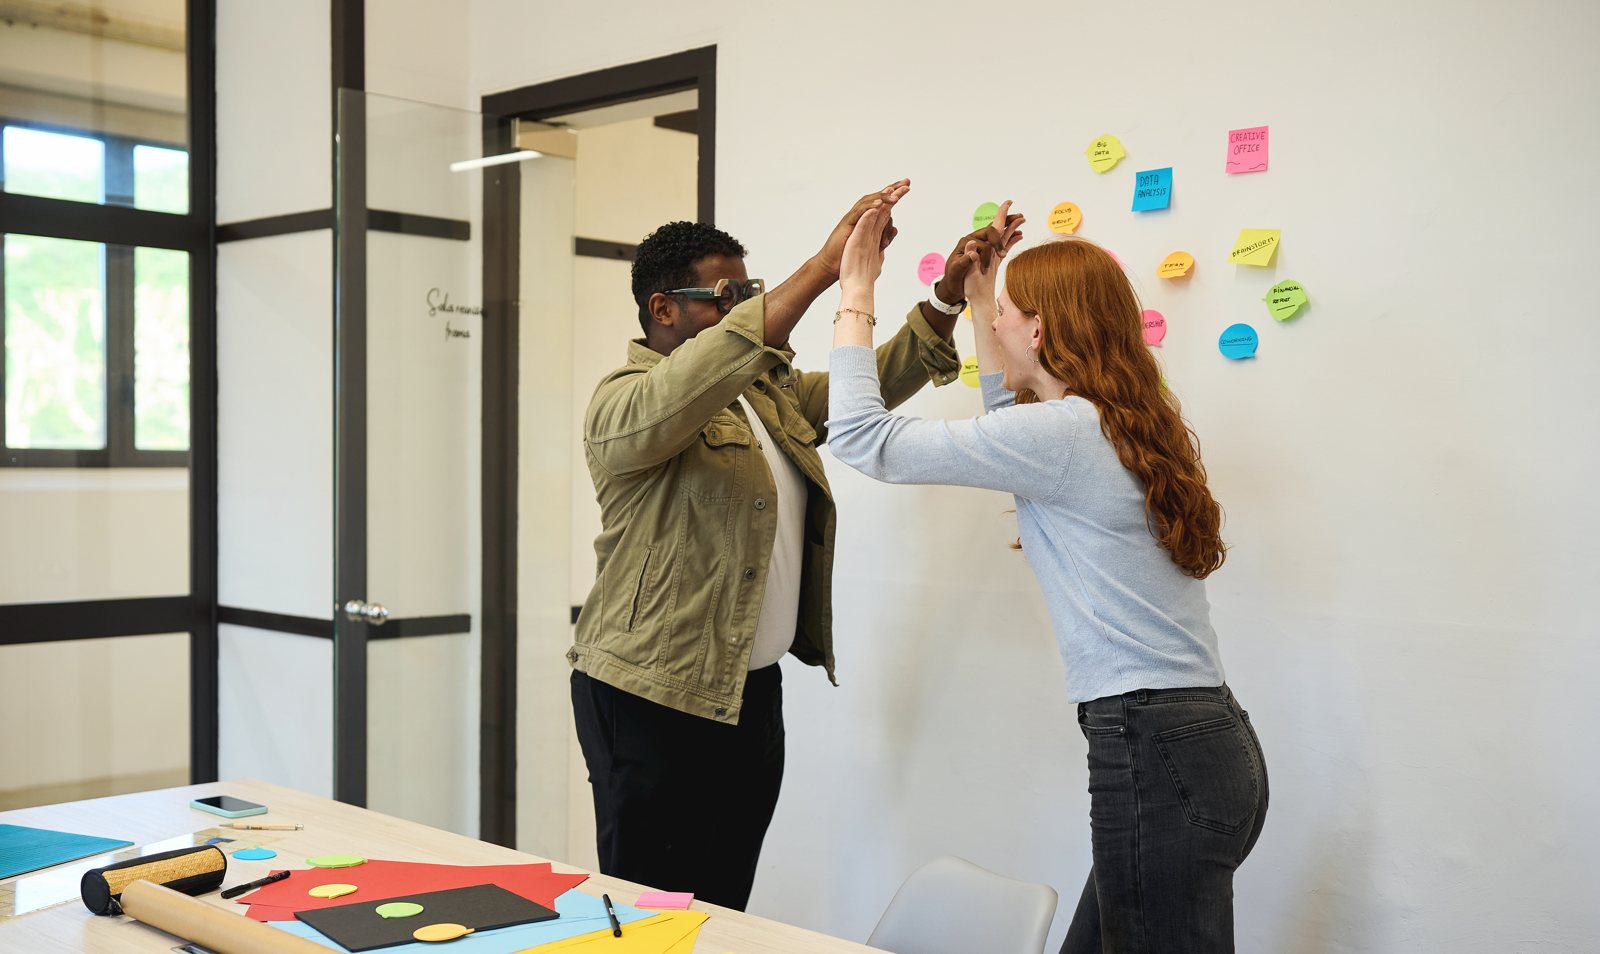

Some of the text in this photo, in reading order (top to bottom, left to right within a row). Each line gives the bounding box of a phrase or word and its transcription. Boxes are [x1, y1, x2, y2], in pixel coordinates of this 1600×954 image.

[1230, 131, 1266, 143] CREATIVE
[1233, 143, 1260, 155] OFFICE
[1140, 174, 1159, 188] DATA
[1137, 187, 1168, 199] ANALYSIS
[1054, 207, 1072, 215] FOCUS
[1051, 217, 1072, 225] GROUP
[1232, 236, 1275, 258] BRAINSTORM
